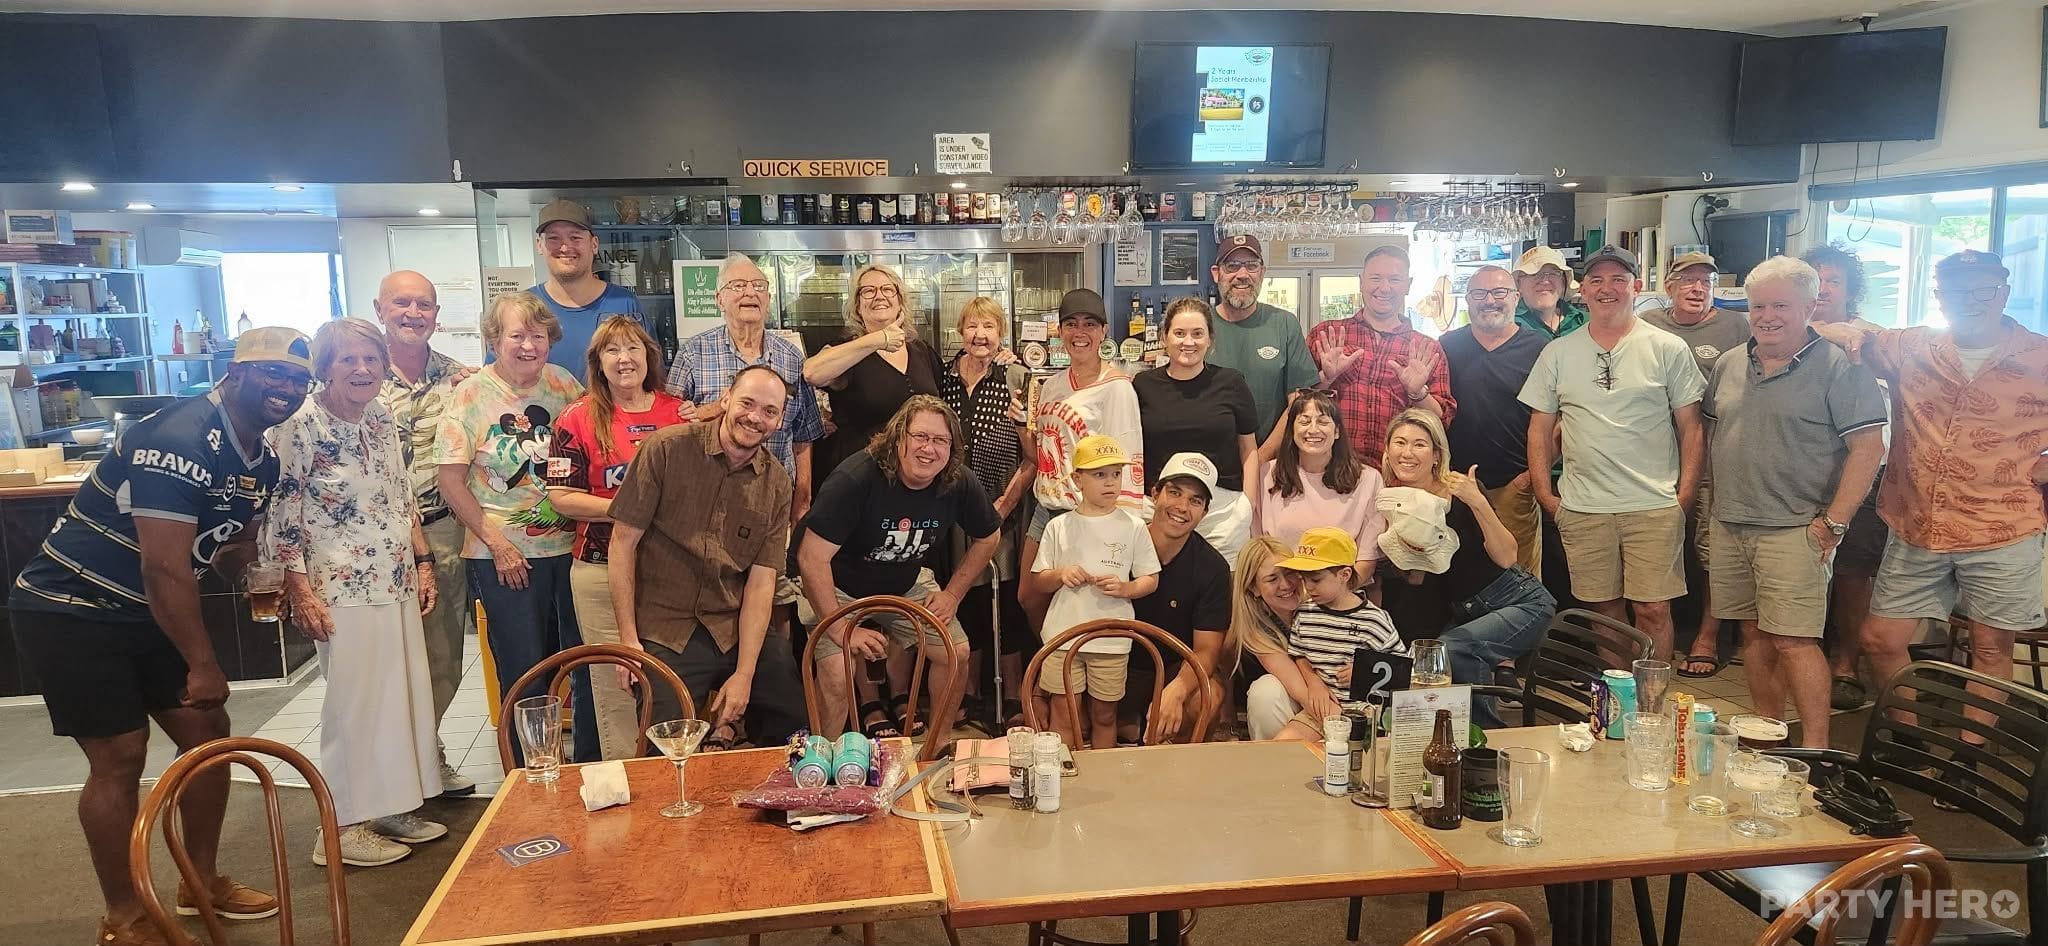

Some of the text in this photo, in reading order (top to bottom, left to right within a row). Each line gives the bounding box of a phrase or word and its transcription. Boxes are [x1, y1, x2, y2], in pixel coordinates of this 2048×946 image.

[1218, 67, 1236, 75] Years
[745, 161, 886, 177] QUICK SERVICE
[132, 449, 213, 487] BRAVUS
[1369, 661, 1393, 698] 2
[1678, 706, 1689, 778] TOBLERONE
